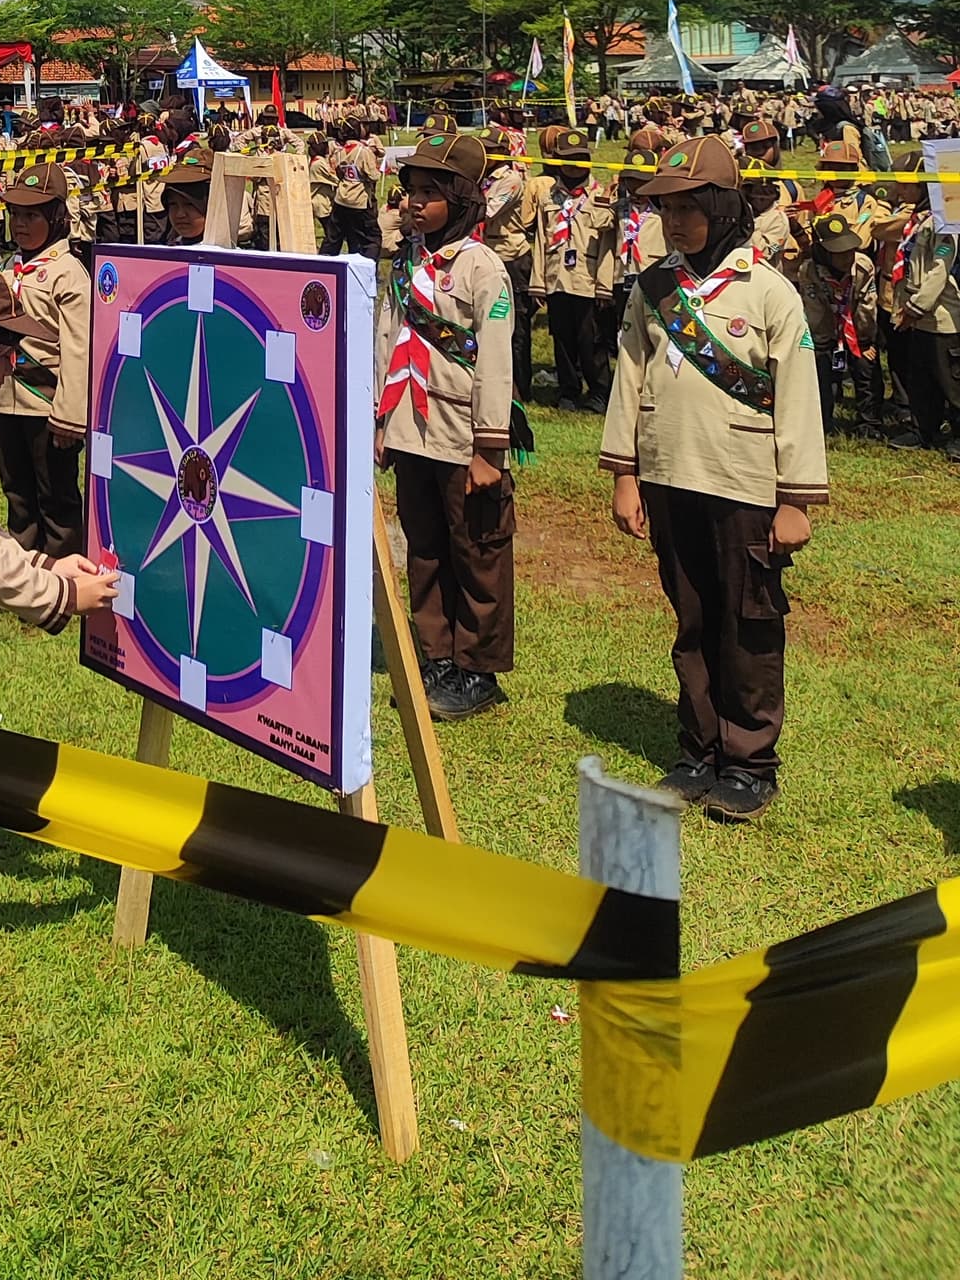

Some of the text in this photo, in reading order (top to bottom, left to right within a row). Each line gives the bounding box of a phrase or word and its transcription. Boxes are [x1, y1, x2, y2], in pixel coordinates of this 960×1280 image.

[257, 713, 330, 755] KWARTIR CABANG
[269, 733, 316, 763] BANYUMAS
